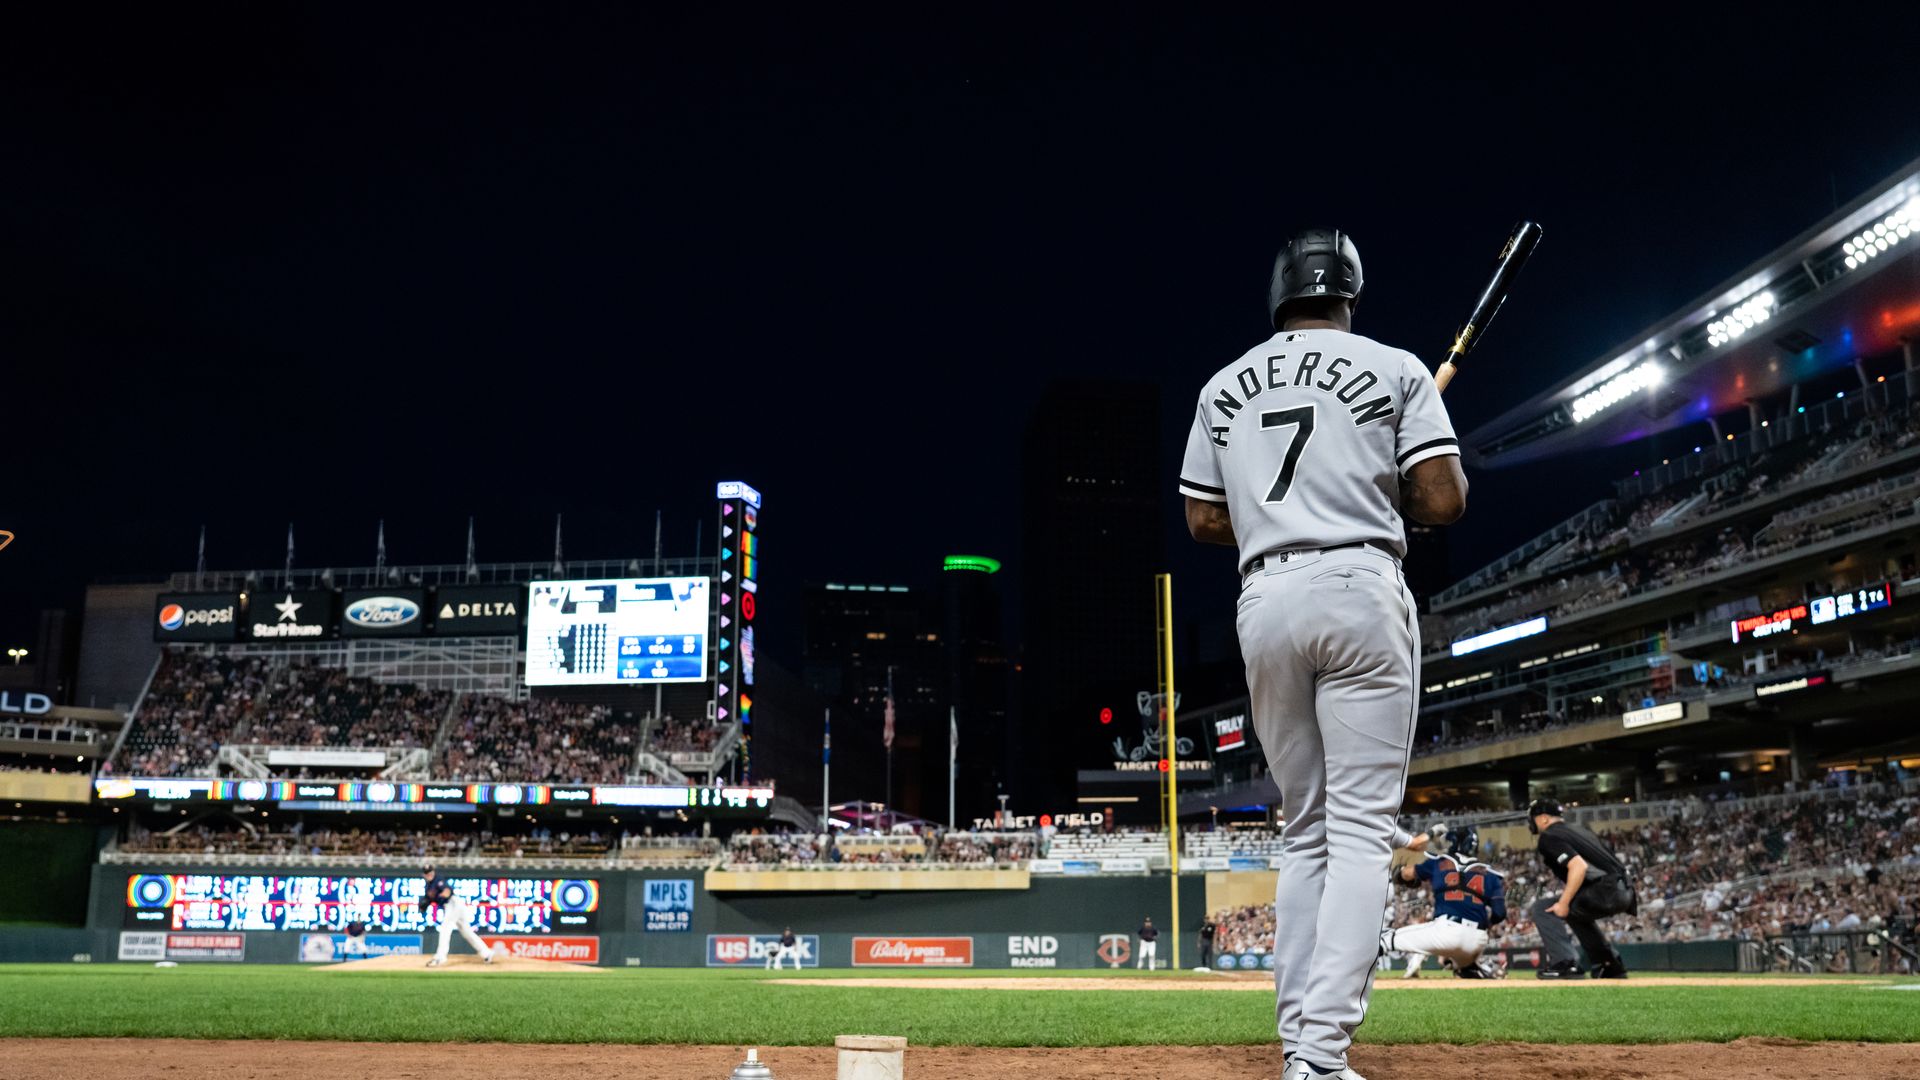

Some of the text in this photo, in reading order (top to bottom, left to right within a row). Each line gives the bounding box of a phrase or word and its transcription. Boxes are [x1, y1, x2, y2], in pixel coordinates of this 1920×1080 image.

[1314, 269, 1325, 283] 7
[1211, 350, 1396, 449] ANDERSON
[1259, 402, 1317, 506] 7
[184, 605, 234, 627] pepsi
[359, 605, 405, 622] Ford
[458, 602, 516, 616] DELTA
[1215, 714, 1245, 737] TRULY
[1114, 761, 1158, 771] TARGET
[651, 883, 687, 901] MPLS
[647, 911, 689, 922] THIS IS
[647, 922, 688, 930] OUR CITY
[870, 940, 912, 961] Bally
[1008, 936, 1059, 954] END
[1011, 957, 1056, 967] RACISM
